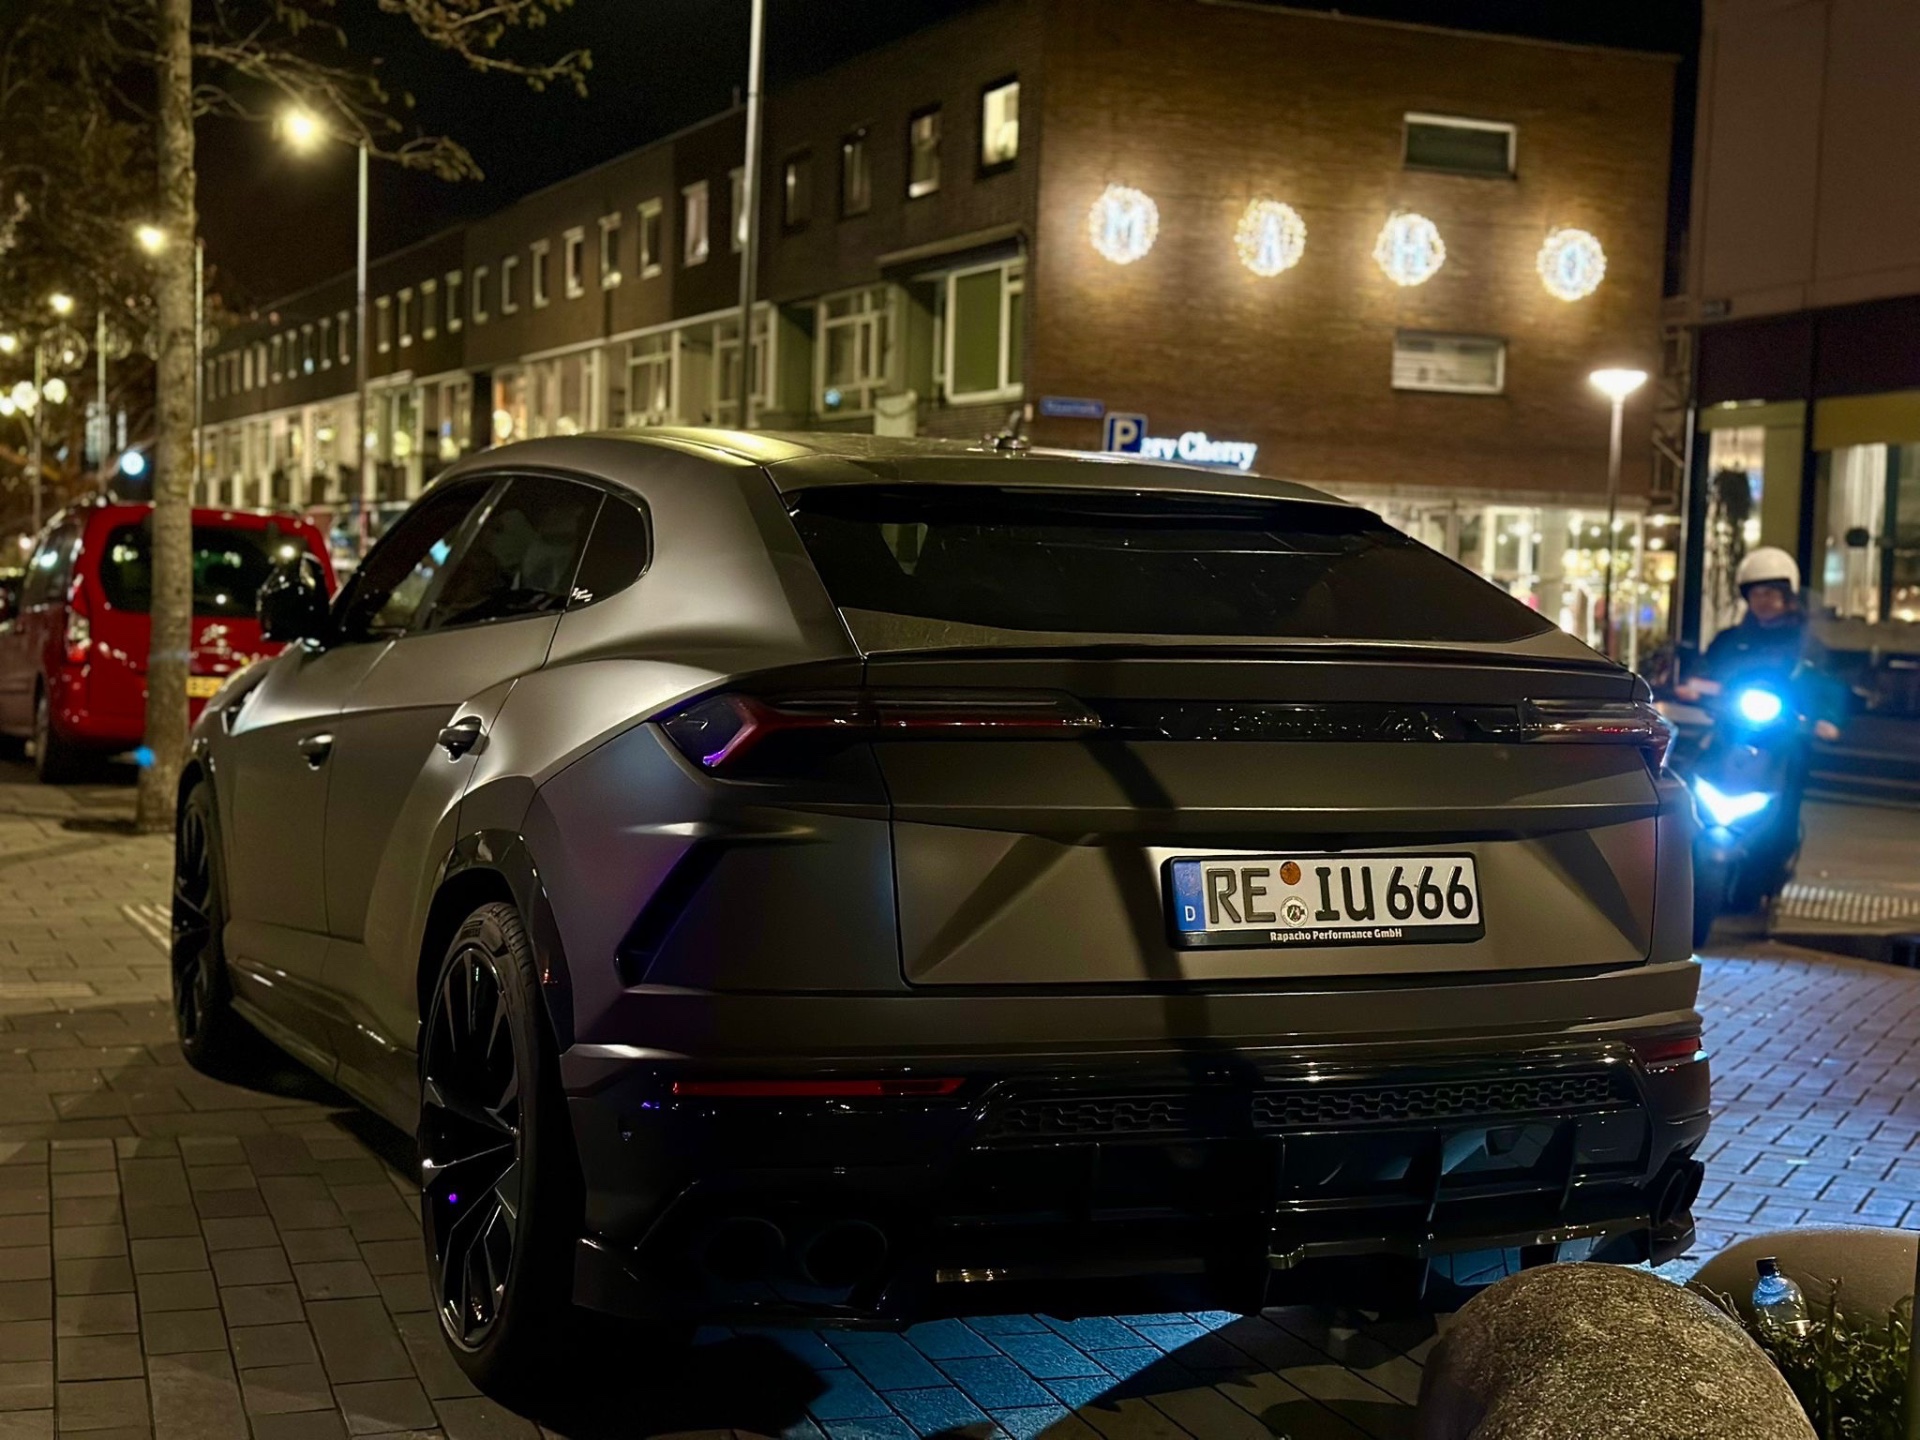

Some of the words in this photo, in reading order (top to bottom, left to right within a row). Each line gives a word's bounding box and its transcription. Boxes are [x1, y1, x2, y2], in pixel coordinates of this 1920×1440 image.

[1112, 420, 1139, 452] P
[1178, 432, 1257, 470] Cherry
[1206, 867, 1276, 924] RE
[1315, 866, 1375, 921] IU
[1386, 866, 1473, 920] 666
[1184, 905, 1196, 922] D
[1269, 931, 1311, 942] Rapacho
[1312, 929, 1373, 940] Performance
[1374, 928, 1403, 938] GmbH
